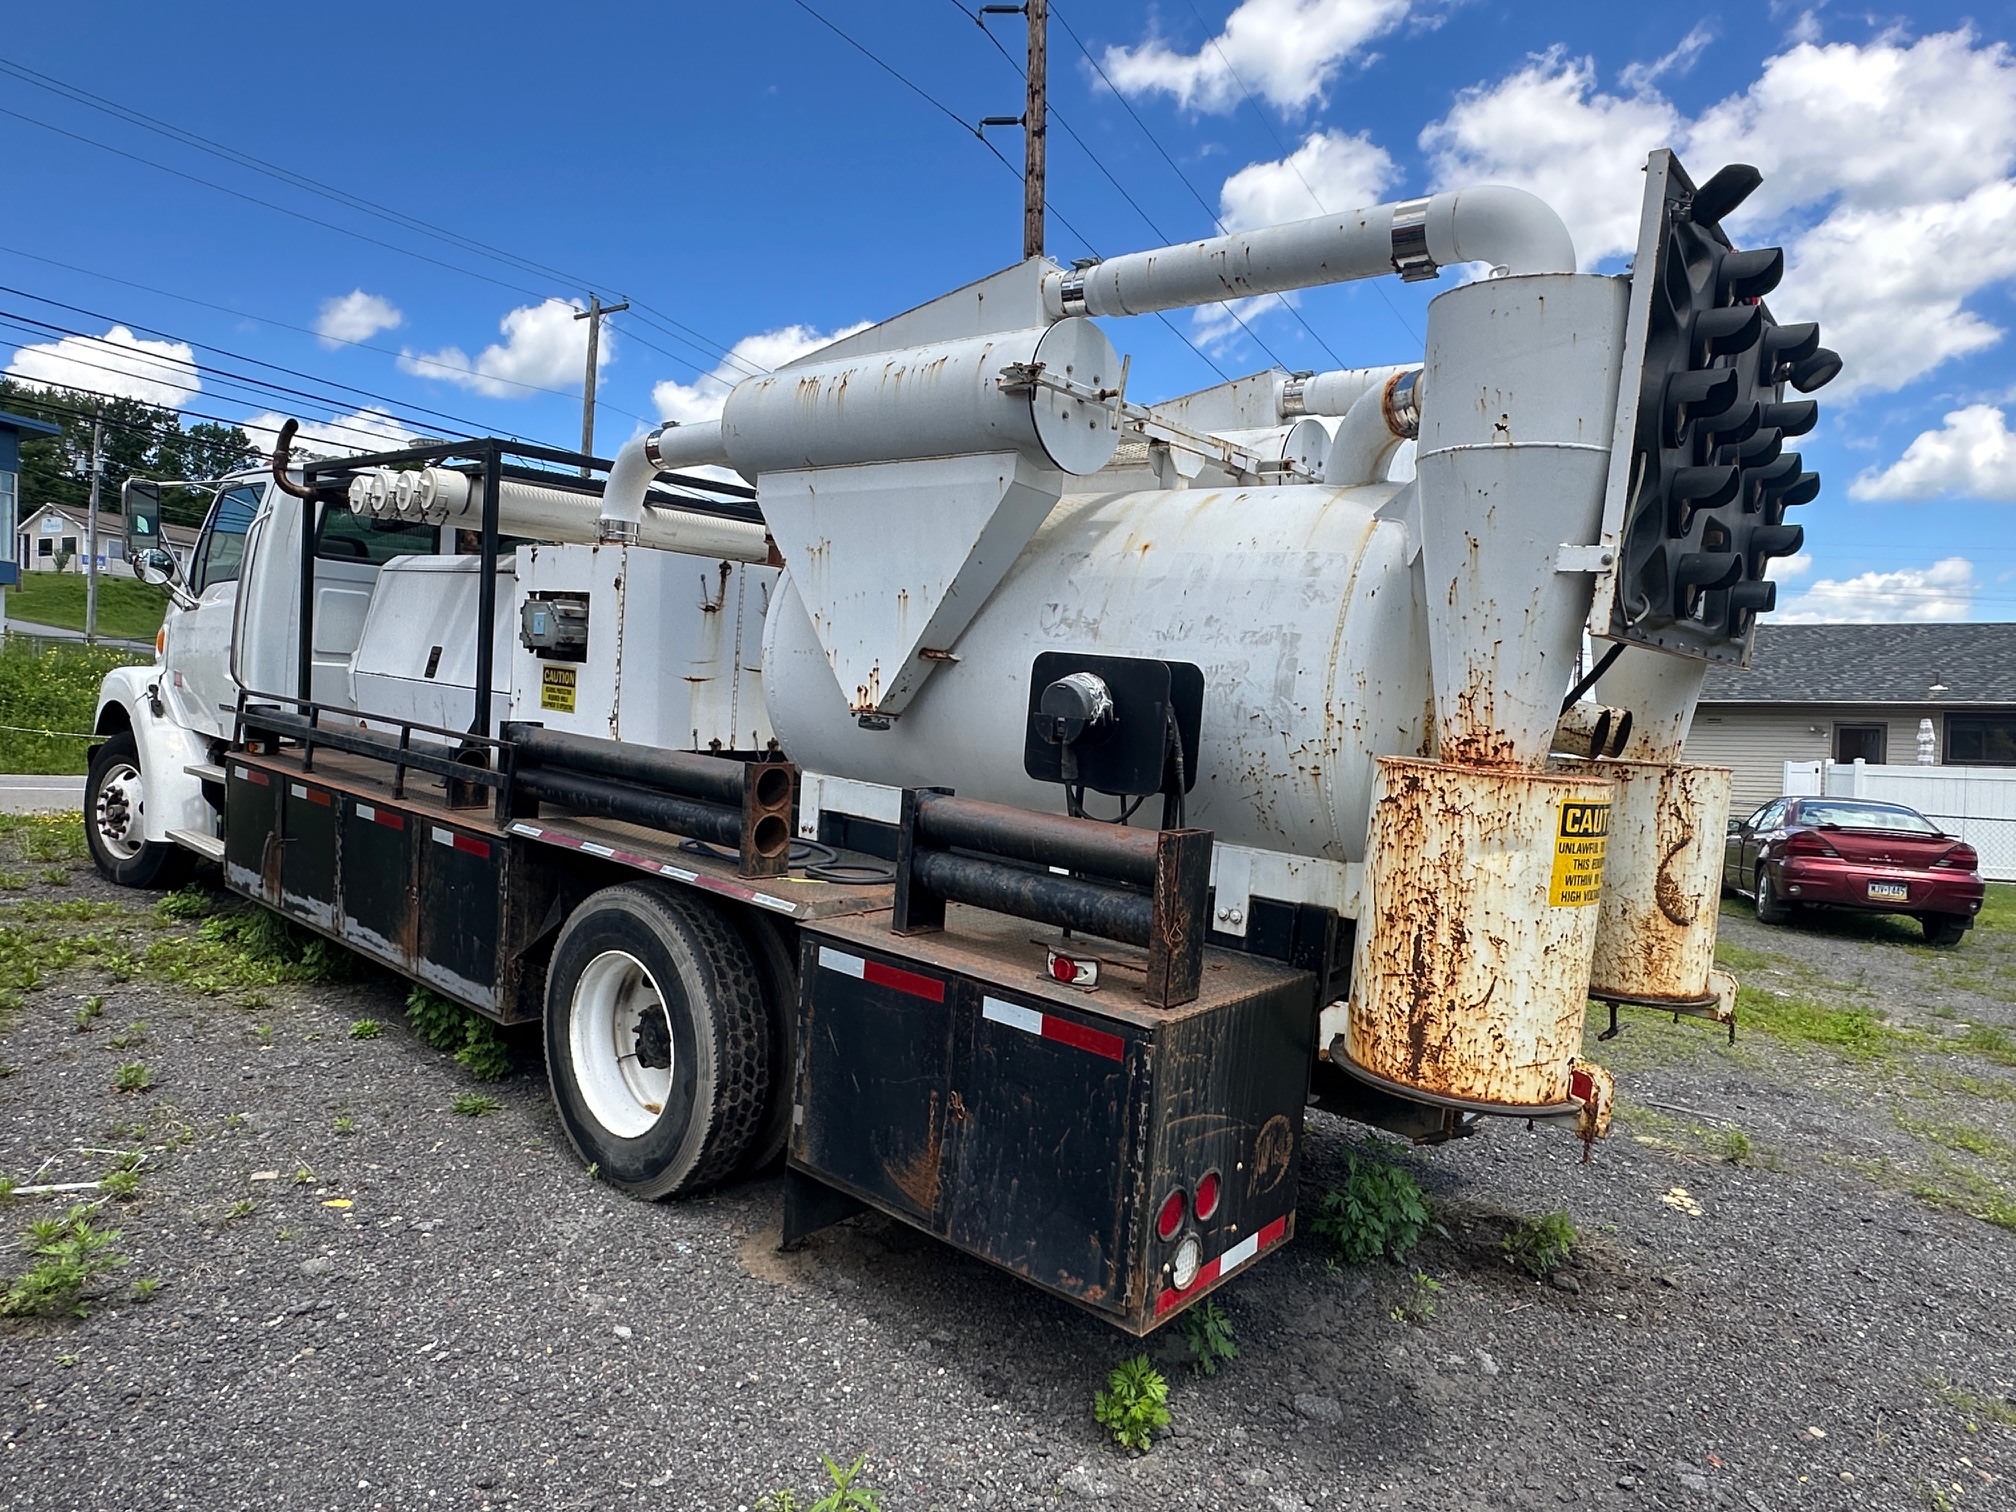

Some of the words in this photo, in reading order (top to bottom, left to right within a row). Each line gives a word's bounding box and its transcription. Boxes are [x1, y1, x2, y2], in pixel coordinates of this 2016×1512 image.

[544, 669, 575, 686] CAUTION
[1558, 842, 1598, 854] UNLAWFUL
[1573, 858, 1590, 870] THIS
[1565, 873, 1593, 886] WITHIN
[1560, 890, 1582, 903] HIGH
